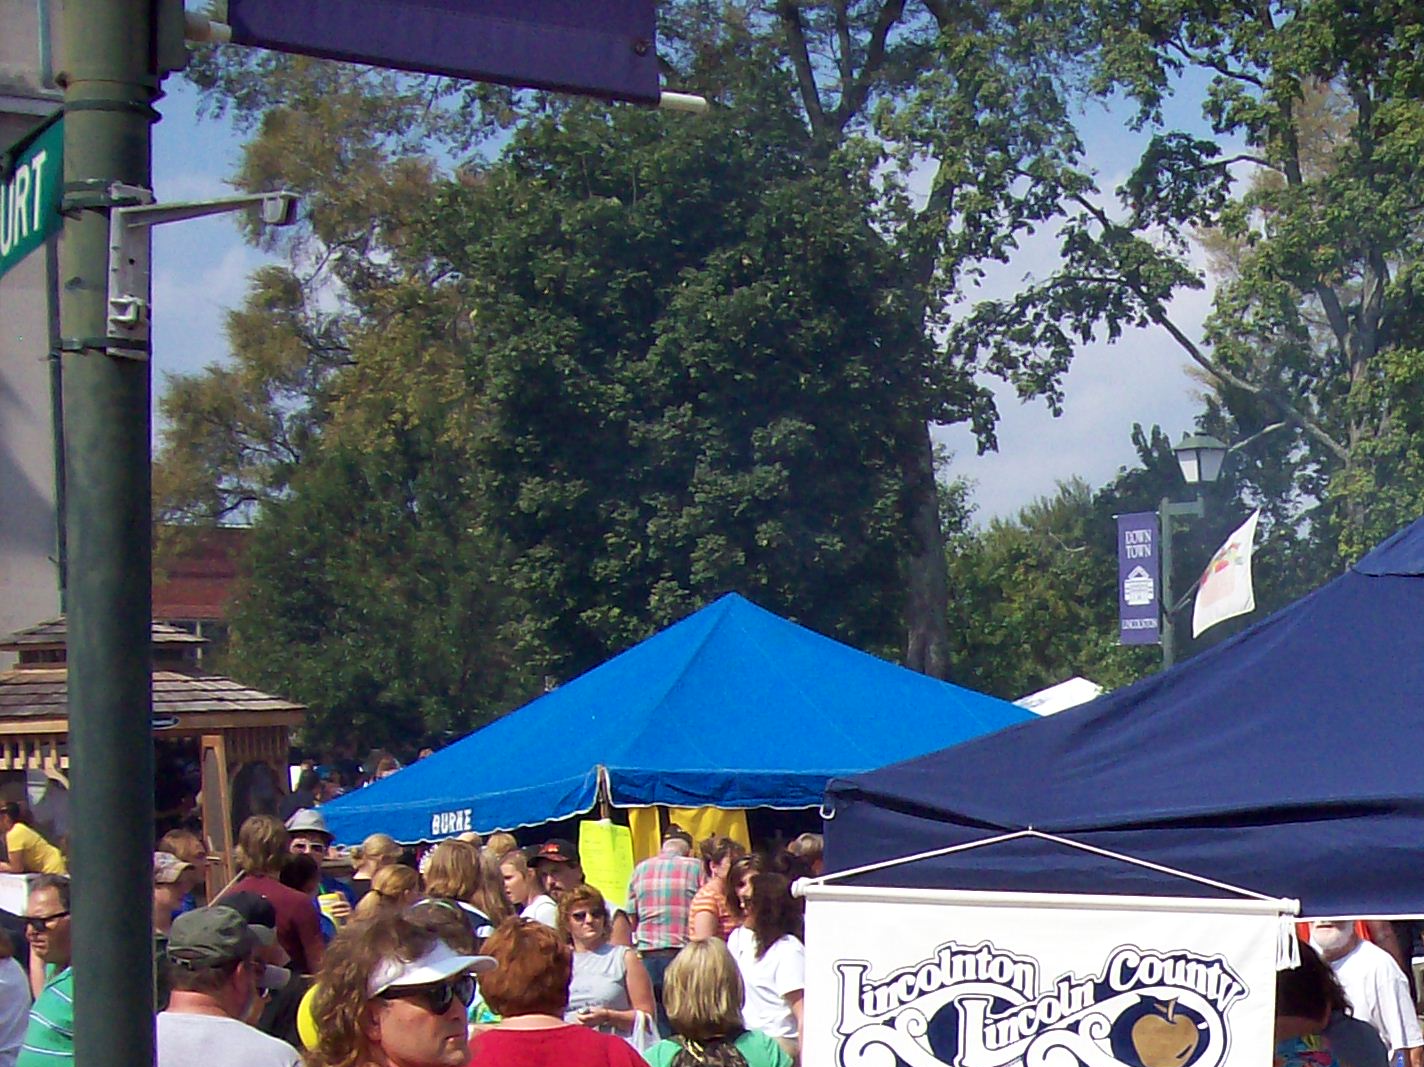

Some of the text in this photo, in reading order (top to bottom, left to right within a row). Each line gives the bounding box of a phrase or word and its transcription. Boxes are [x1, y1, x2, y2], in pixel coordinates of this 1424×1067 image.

[1125, 529, 1152, 545] DOWN
[1126, 544, 1152, 559] TOWN
[836, 944, 1038, 1035] Lincolnton
[1108, 947, 1245, 1012] County
